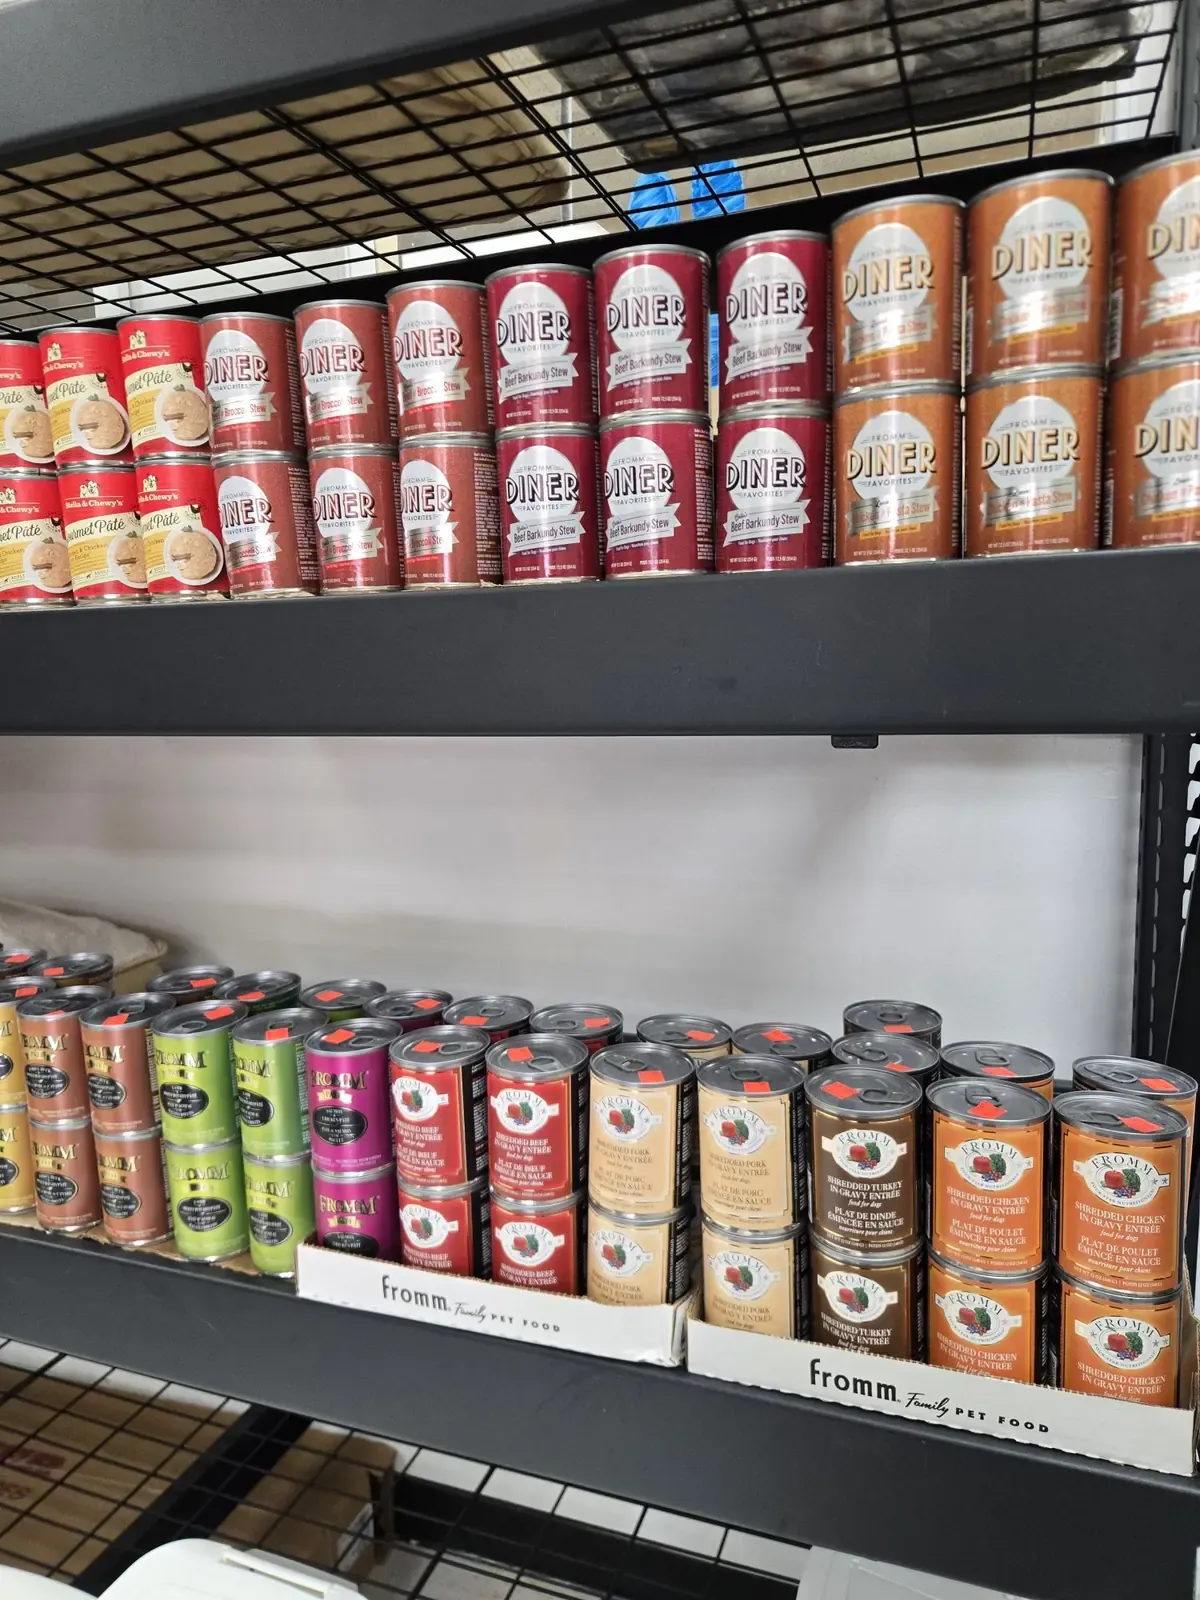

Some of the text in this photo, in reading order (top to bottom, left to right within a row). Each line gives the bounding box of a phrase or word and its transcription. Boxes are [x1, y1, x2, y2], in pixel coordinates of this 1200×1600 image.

[991, 230, 1094, 280] DINER
[843, 254, 935, 304] DINER
[726, 282, 807, 324] DINER
[606, 294, 686, 332] DINER
[496, 311, 571, 346] DINER
[392, 327, 464, 362] DINER
[137, 350, 170, 359] Chewy's
[300, 345, 368, 378] DINER
[615, 353, 682, 374] Beef Barkundy Stew
[732, 342, 802, 367] Beef Stew
[143, 370, 173, 386] Pâté
[204, 355, 270, 386] DINER
[505, 374, 518, 387] Beef
[518, 370, 550, 385] Barkundy
[551, 366, 568, 377] Stew
[59, 380, 86, 395] Pâté
[444, 381, 461, 391] Stew
[981, 428, 1080, 469] DINER
[847, 441, 937, 480] DINER
[726, 457, 807, 492] DINER
[1004, 465, 1053, 476] FAVORITES
[506, 472, 580, 505] DINER
[604, 464, 675, 499] DINER
[867, 477, 912, 487] FAVORITES
[88, 499, 124, 508] Chewy's
[150, 493, 179, 502] Chewy's
[313, 492, 377, 521] DINER
[523, 503, 559, 511] FAVORITES
[6, 504, 40, 513] Chewy's
[95, 518, 126, 534] Pâté
[153, 513, 181, 527] Pâté
[610, 518, 669, 538] Beef Barkundy Stew
[731, 514, 800, 532] Beef Barkundy Stew
[12, 523, 42, 537] Pâté
[514, 525, 576, 543] Beef Barkundy Stew
[311, 1071, 368, 1091] FROMM
[500, 1089, 546, 1110] FROMM
[602, 1096, 645, 1114] FROMM
[713, 1107, 759, 1125] FROMM
[415, 1133, 443, 1141] ENTRÉE
[532, 1138, 549, 1146] BEEF
[838, 1131, 893, 1147] FROMM
[523, 1145, 552, 1153] ENTRÉE
[961, 1141, 1018, 1160] FROMM
[738, 1168, 770, 1176] ENTRÉE
[746, 1160, 767, 1168] PORK
[1091, 1154, 1153, 1176] FROMM
[528, 1171, 553, 1180] SAUCE
[828, 1175, 903, 1191] SHREDDED TURKEY
[745, 1196, 772, 1205] SAUCE
[830, 1184, 901, 1200] IN GRAVY ENTRÉE
[946, 1187, 1030, 1206] SHREDDED CHICKEN
[320, 1195, 377, 1216] FROMM
[835, 1206, 897, 1221] PLAT DE DINDE
[848, 1199, 883, 1209] food for dogs
[951, 1196, 1026, 1215] IN GRAVY ENTRÉE
[1075, 1200, 1166, 1225] SHREDDED CHICKEN
[828, 1211, 904, 1229] ÉMINCÉE EN SAUCE
[969, 1212, 992, 1223] food for
[1080, 1211, 1161, 1234] IN GRAVY ENTRÉE
[506, 1223, 550, 1242] FROMM
[952, 1218, 1024, 1237] PLAT DE POULET
[1100, 1229, 1139, 1243] food for dogs
[984, 1235, 1027, 1245] EN SAUCE
[1081, 1235, 1158, 1257] PLAT DE POULET
[718, 1254, 763, 1272] FROMM
[1078, 1243, 1161, 1266] ÉMINCÉ EN SAUCE
[1118, 1265, 1151, 1275] pour chiens
[528, 1276, 558, 1285] ENTRÉE
[829, 1273, 880, 1294] FROMM
[382, 1275, 561, 1332] fromm Family PET FOOD
[948, 1293, 1003, 1317] FROMM
[741, 1313, 773, 1323] ENTRÉE
[821, 1312, 893, 1337] SHREDDED TURKEY
[1094, 1316, 1156, 1339] FROMM
[823, 1322, 890, 1345] IN GRAVY ENTRÉE
[937, 1332, 1017, 1361] SHREDDED CHICKEN
[940, 1342, 1013, 1371] IN GRAVY ENTRÉE
[1077, 1361, 1166, 1386] SHREDDED CHICKEN
[1082, 1372, 1162, 1395] IN GRAVY ENTRÉE
[810, 1358, 1050, 1433] fromm Family PET FOOD
